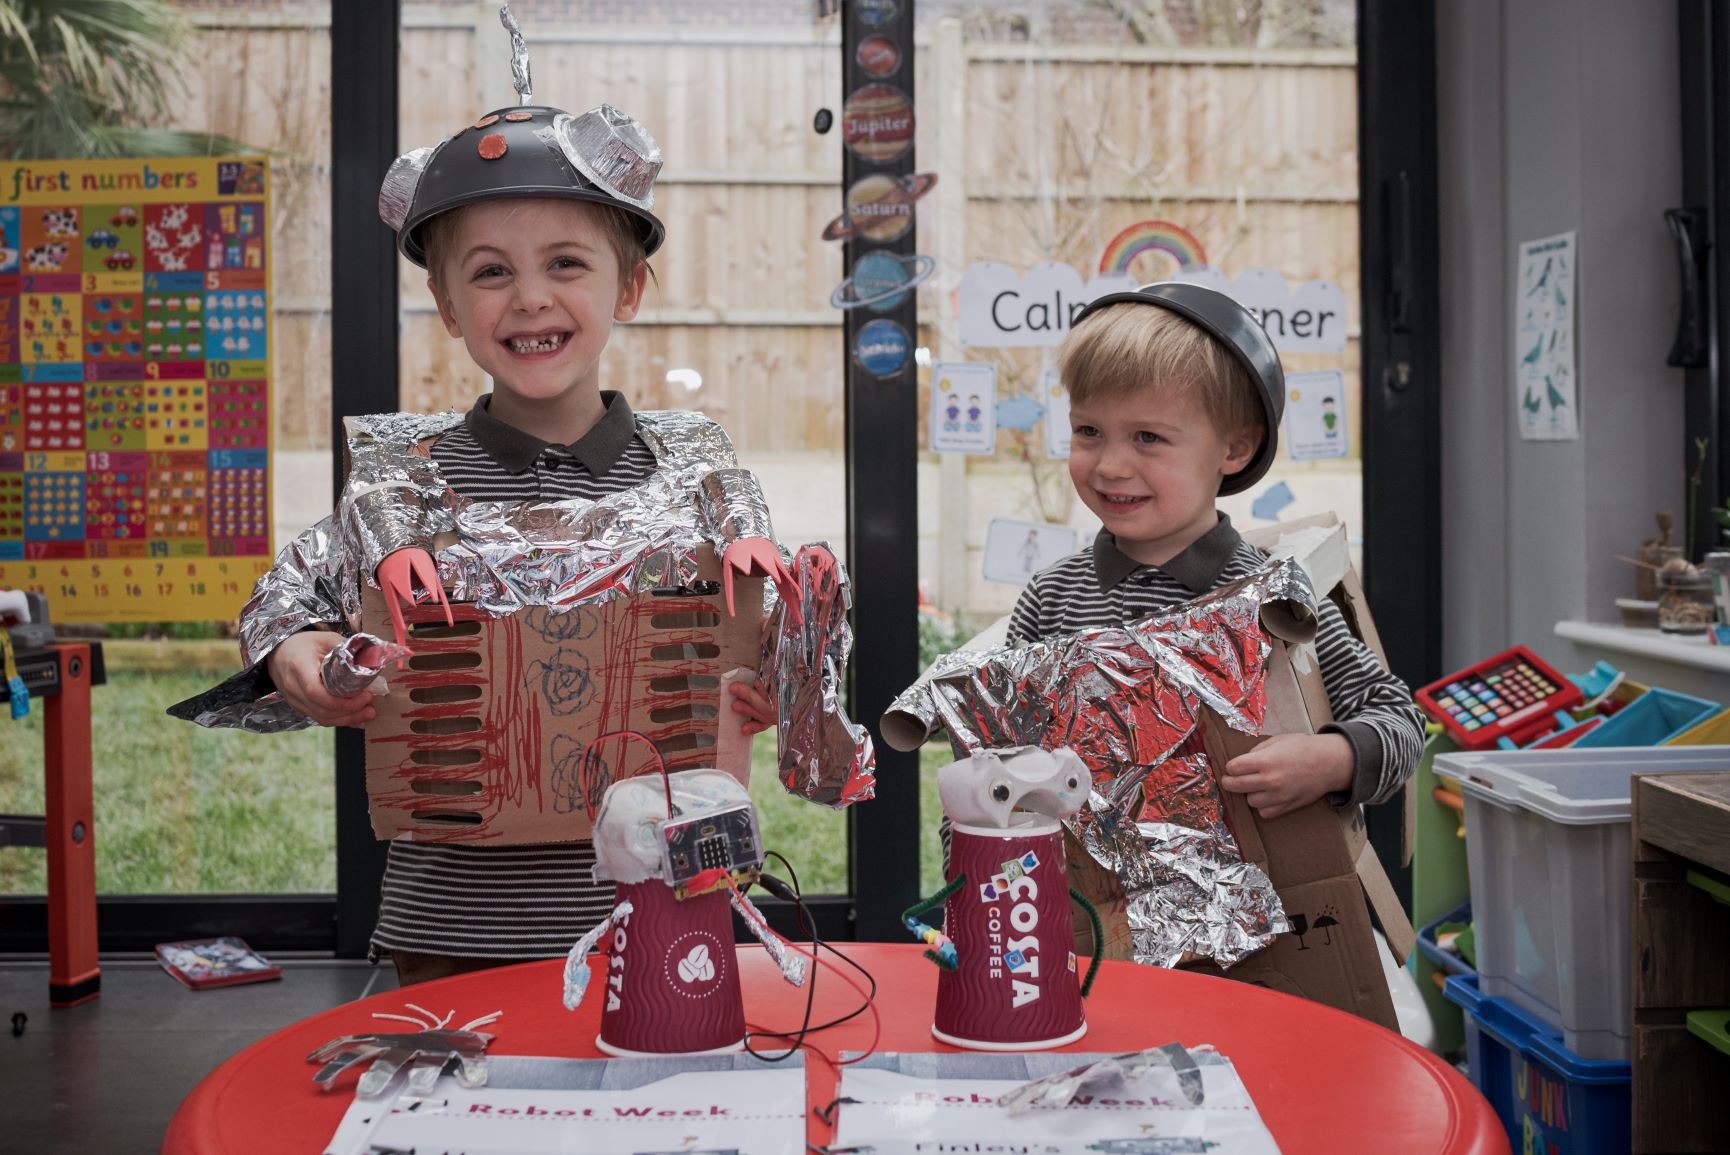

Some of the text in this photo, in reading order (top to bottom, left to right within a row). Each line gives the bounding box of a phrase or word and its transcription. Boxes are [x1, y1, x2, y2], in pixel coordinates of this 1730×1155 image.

[850, 117, 910, 138] Jupiter
[8, 164, 198, 202] first numbers
[851, 202, 910, 217] Saturn
[85, 274, 97, 292] 3
[207, 270, 221, 290] 5
[1249, 307, 1335, 338] ner
[146, 362, 159, 380] 9
[209, 361, 231, 378] 10
[28, 453, 48, 470] 12
[89, 452, 110, 470] 13
[211, 450, 232, 468] 15
[28, 543, 48, 559] 17
[150, 541, 169, 557] 19
[211, 540, 235, 557] 20
[29, 565, 36, 579] 3
[60, 565, 69, 578] 4
[91, 564, 100, 578] 5
[124, 564, 133, 577] 6
[156, 563, 164, 576] 7
[187, 562, 196, 576] 8
[219, 561, 228, 574] 9
[253, 561, 269, 574] 10
[61, 584, 77, 597] 14
[94, 583, 109, 597] 15
[126, 583, 142, 597] 16
[158, 583, 173, 596] 17
[190, 582, 206, 595] 18
[222, 581, 238, 593] 19
[988, 906, 1002, 979] COFFEE
[1007, 876, 1040, 1009] COSTA
[1517, 1060, 1569, 1133] JUNK
[469, 1103, 733, 1117] Robot Week
[915, 1142, 1061, 1154] Finley's
